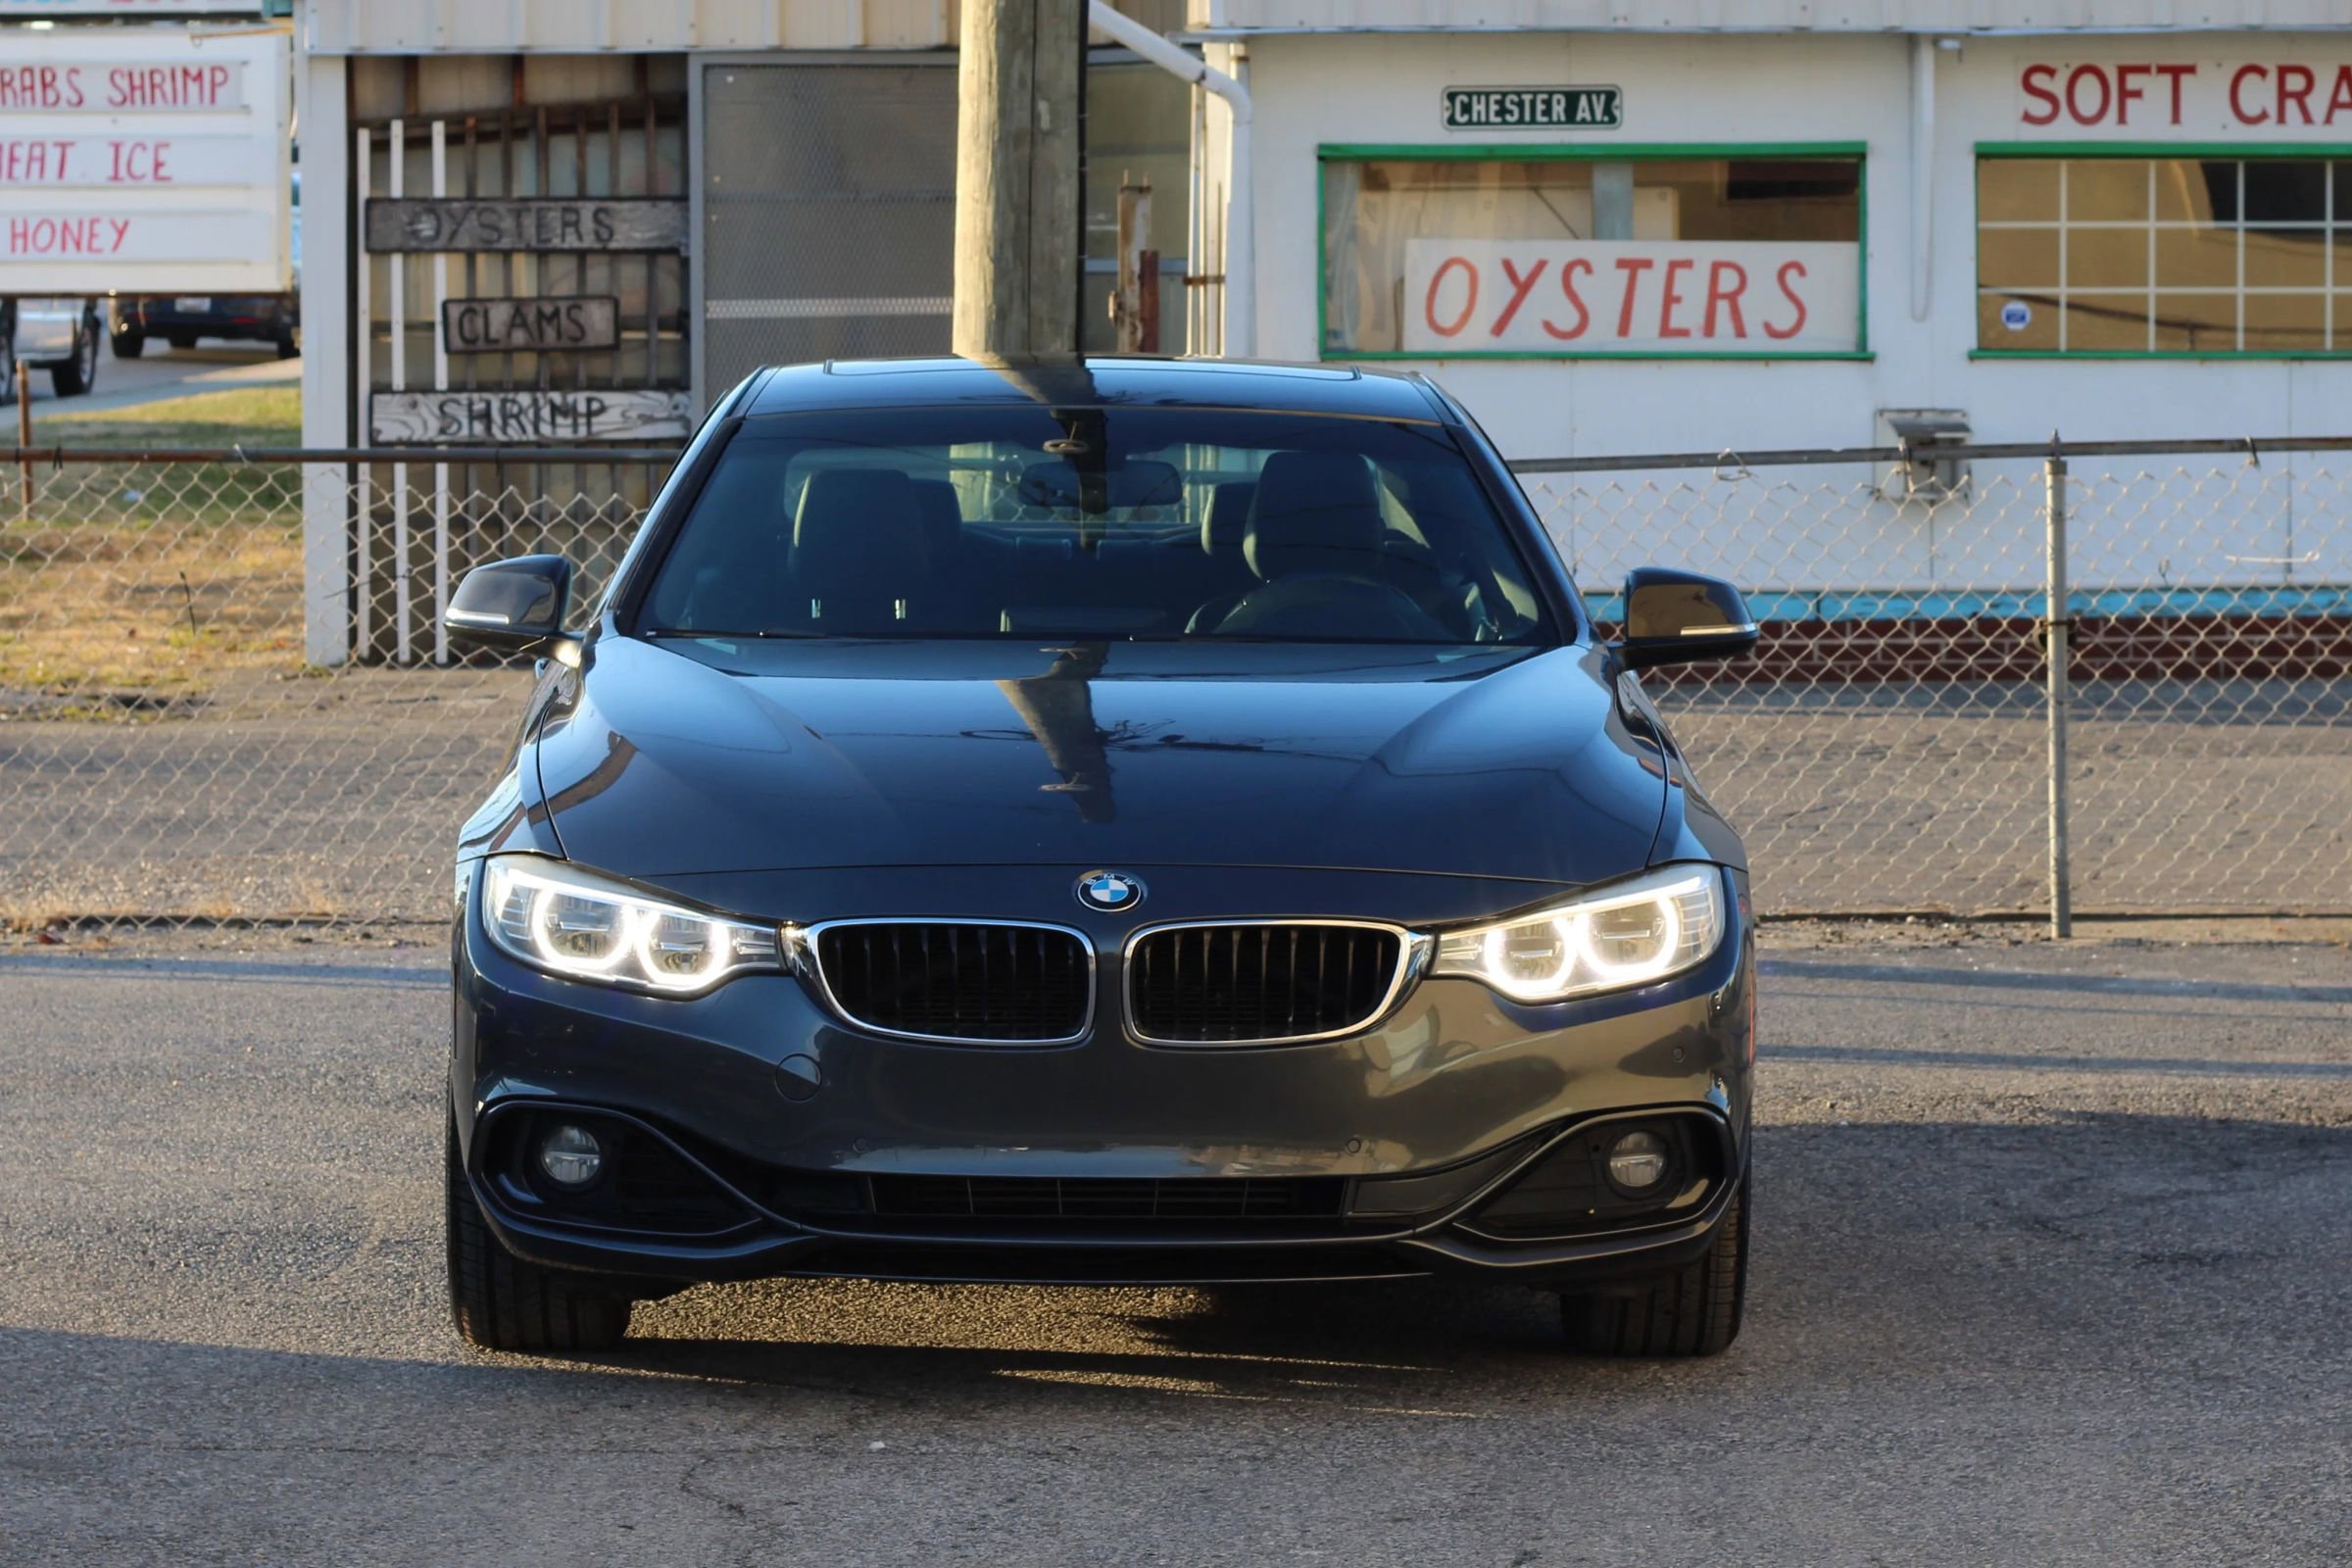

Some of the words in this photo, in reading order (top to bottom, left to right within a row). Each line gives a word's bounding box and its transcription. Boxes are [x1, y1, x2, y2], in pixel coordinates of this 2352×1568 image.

[108, 66, 229, 108] SHRIMP
[2021, 63, 2197, 125] SOFT
[2229, 63, 2352, 125] CRA
[1454, 93, 1566, 123] CHESTER
[1575, 93, 1609, 122] AV.
[0, 141, 75, 182] EAT
[107, 141, 172, 182] ICE
[9, 217, 129, 254] HONEY
[409, 205, 614, 244] OYSTERS
[1425, 257, 1807, 339] OYSTERS
[458, 304, 587, 345] CLAMS
[438, 396, 607, 435] SHRIMP
